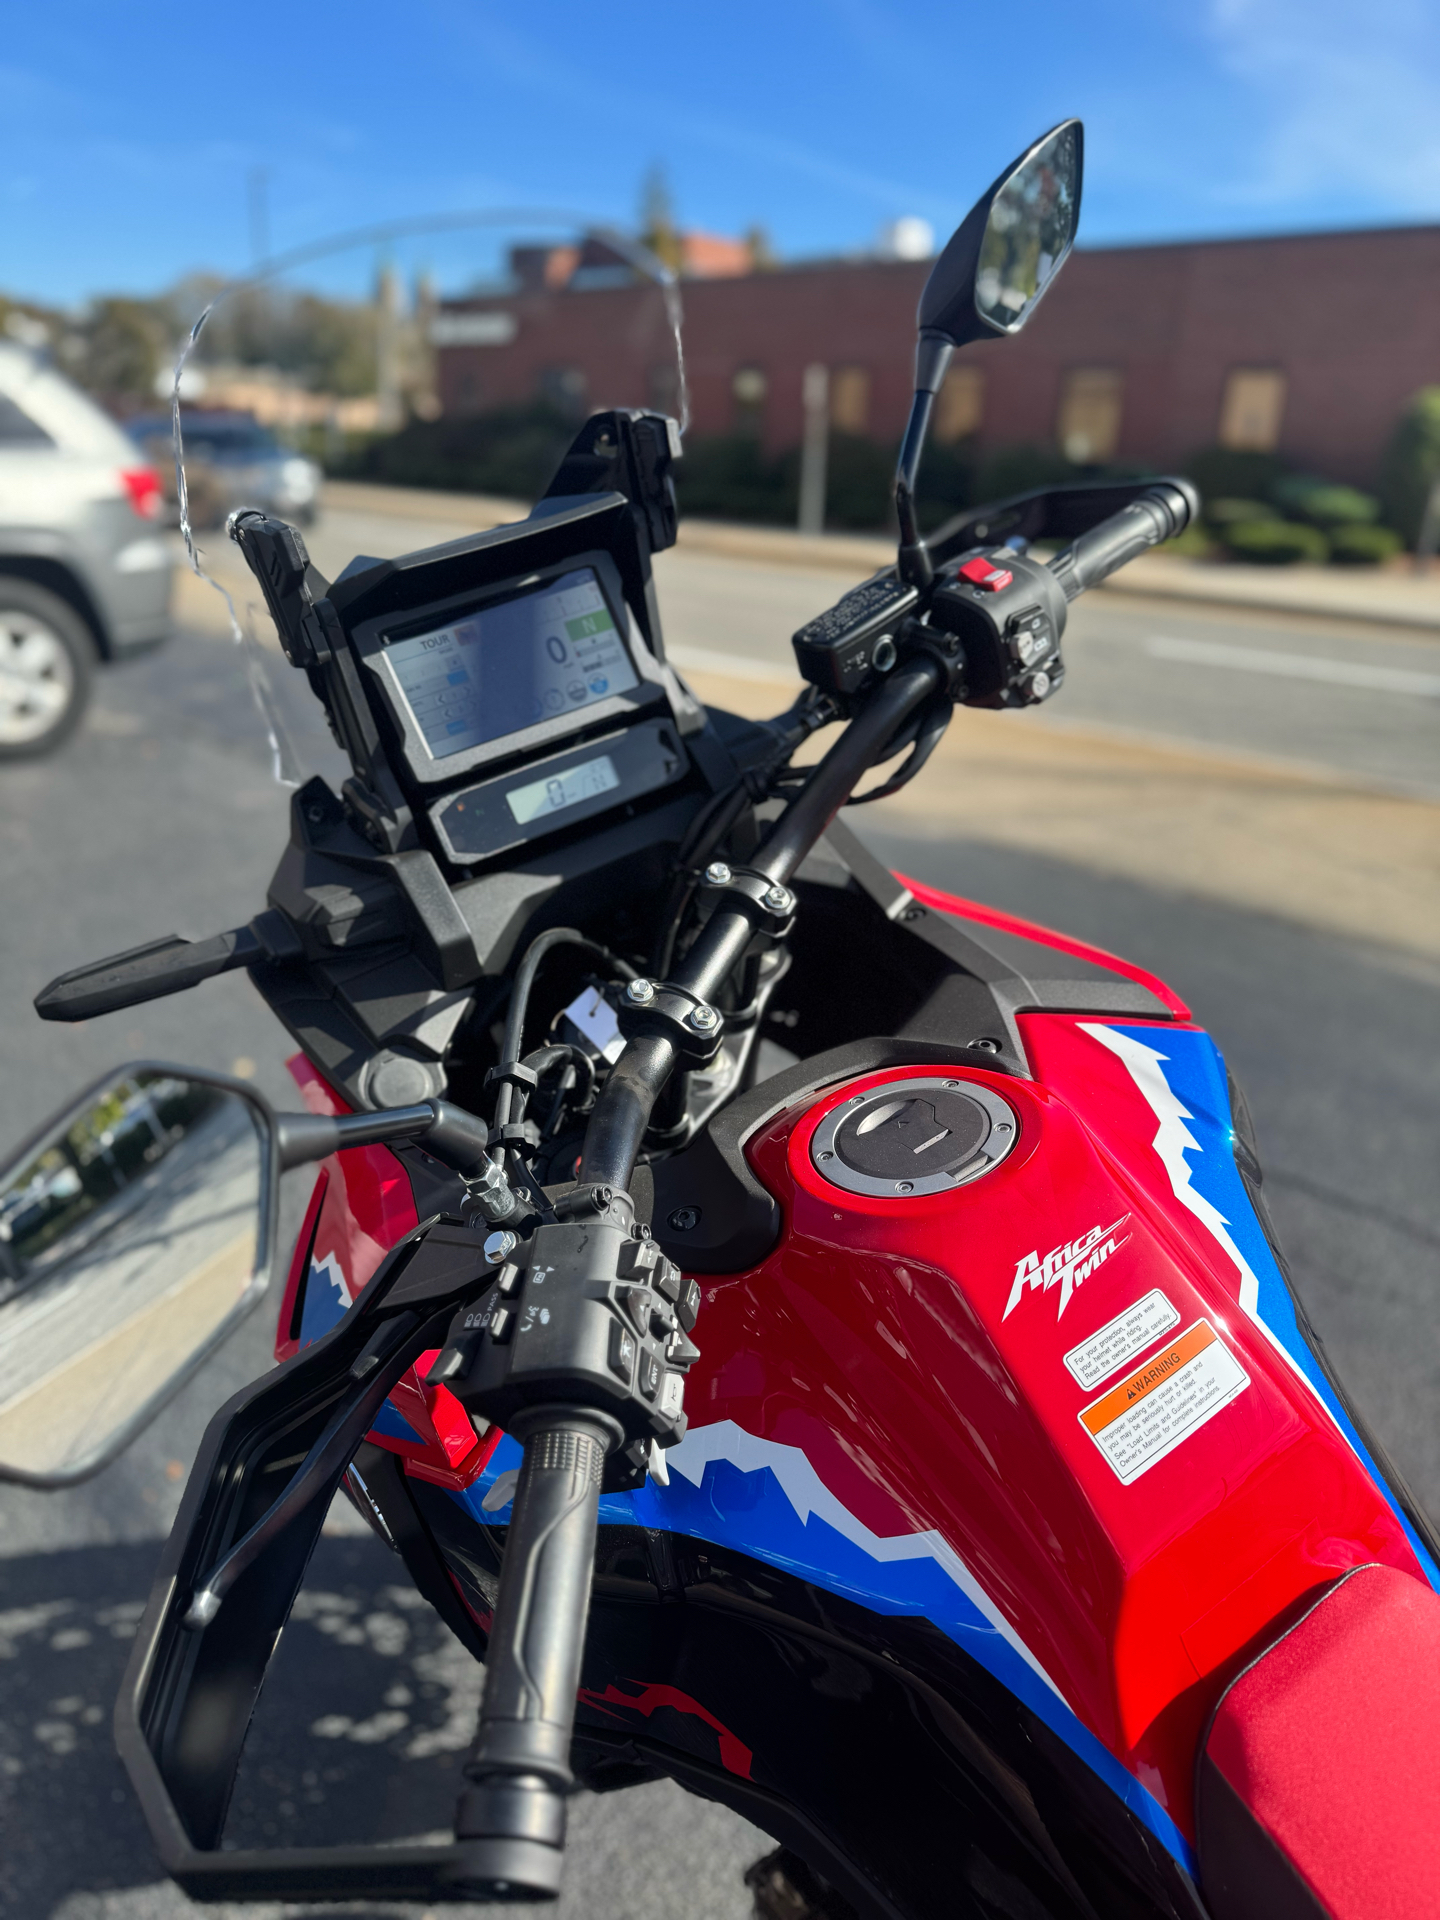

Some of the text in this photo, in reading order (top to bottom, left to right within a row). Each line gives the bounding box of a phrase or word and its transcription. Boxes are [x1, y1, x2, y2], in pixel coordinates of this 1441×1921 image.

[420, 634, 450, 650] TOUR
[546, 635, 568, 665] 0
[581, 617, 597, 634] N
[1001, 1212, 1131, 1323] Africa
[1046, 1234, 1130, 1323] Twin
[487, 1293, 498, 1312] PASS
[1074, 1302, 1155, 1365] For your protection, always wear
[651, 1364, 659, 1386] ENT
[1080, 1362, 1093, 1374] your
[1094, 1346, 1112, 1362] helmet
[1112, 1336, 1126, 1349] while
[1127, 1326, 1143, 1340] riding.
[1085, 1366, 1100, 1380] Read
[1101, 1358, 1111, 1368] the
[1112, 1344, 1132, 1361] owner's
[1132, 1328, 1150, 1344] manual
[1150, 1313, 1172, 1331] carefully.
[1133, 1352, 1181, 1392] WARNING
[1102, 1422, 1126, 1443] Improper
[1126, 1406, 1147, 1424] loading
[1147, 1398, 1157, 1408] can
[1158, 1385, 1173, 1400] cause
[1179, 1370, 1193, 1383] crash
[1193, 1361, 1203, 1372] and
[1108, 1379, 1197, 1451] you may be seriously hurt or killed.
[1114, 1449, 1127, 1460] See
[1143, 1422, 1160, 1437] Limits
[1161, 1412, 1172, 1423] and
[1205, 1377, 1216, 1390] your
[1119, 1449, 1142, 1467] Owner's
[1142, 1433, 1162, 1449] Manual
[1162, 1425, 1171, 1434] for
[1171, 1407, 1194, 1427] complete
[1194, 1386, 1221, 1409] instructions.
